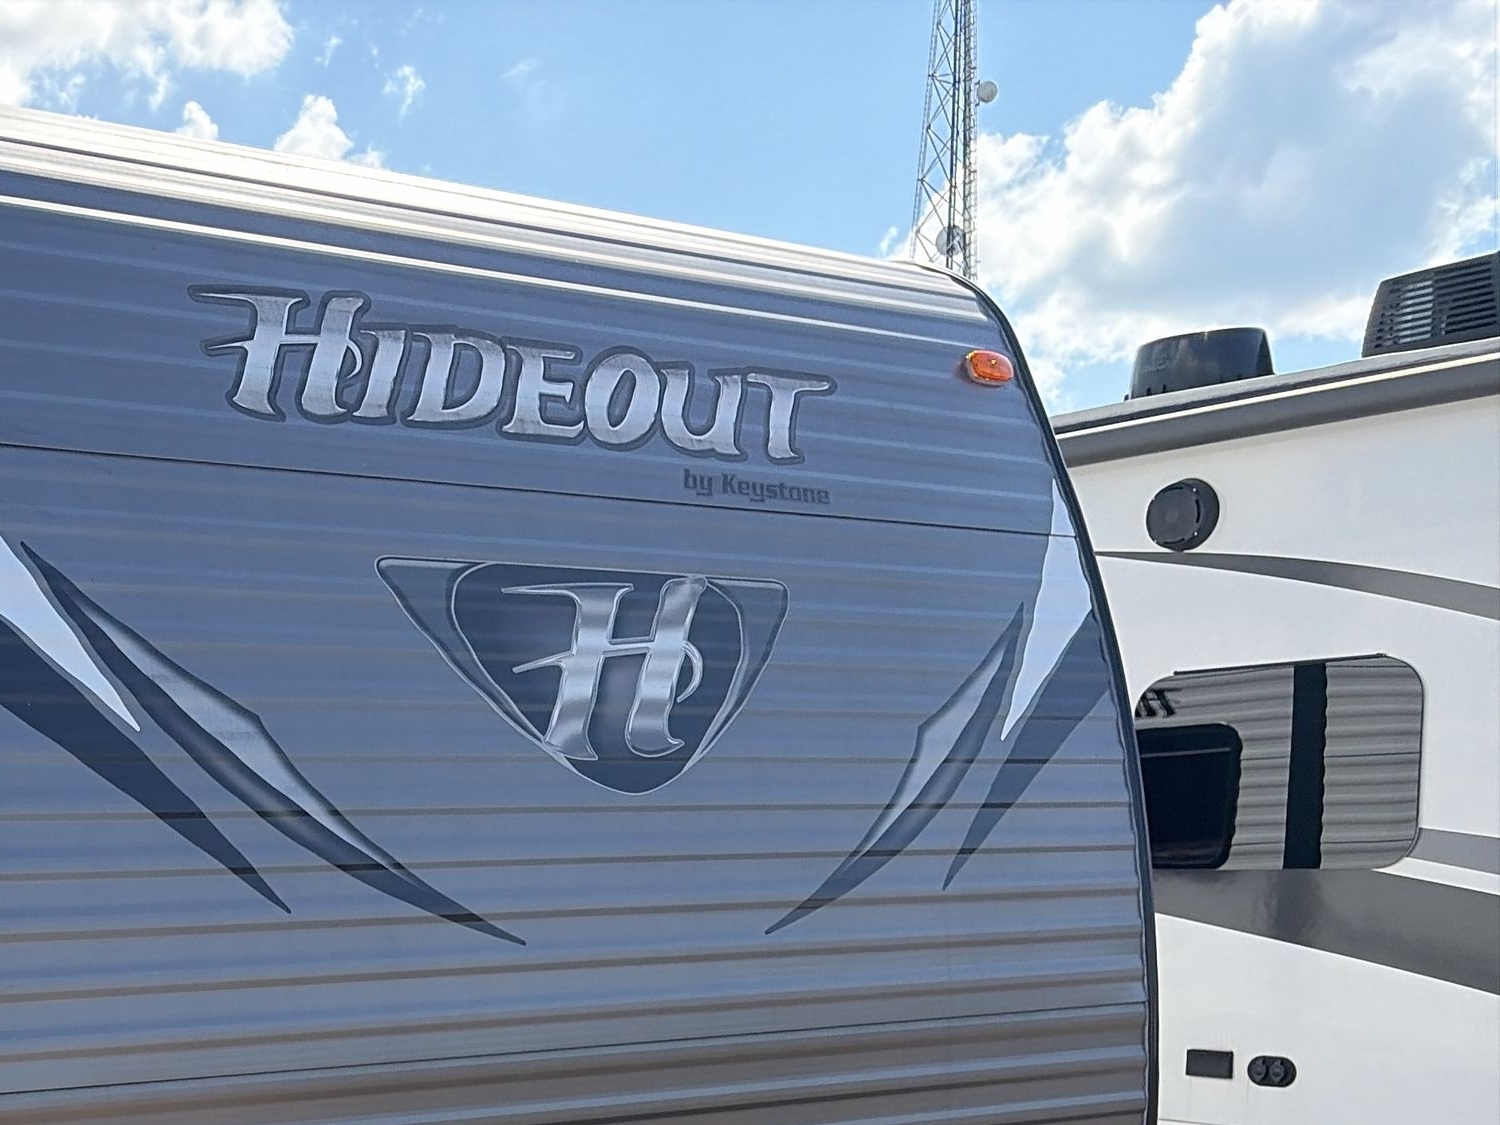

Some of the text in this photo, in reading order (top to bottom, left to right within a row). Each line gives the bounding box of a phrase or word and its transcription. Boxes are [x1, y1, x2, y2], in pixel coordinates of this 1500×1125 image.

[190, 287, 833, 462] HIDEOUT
[684, 468, 831, 504] by Keystone
